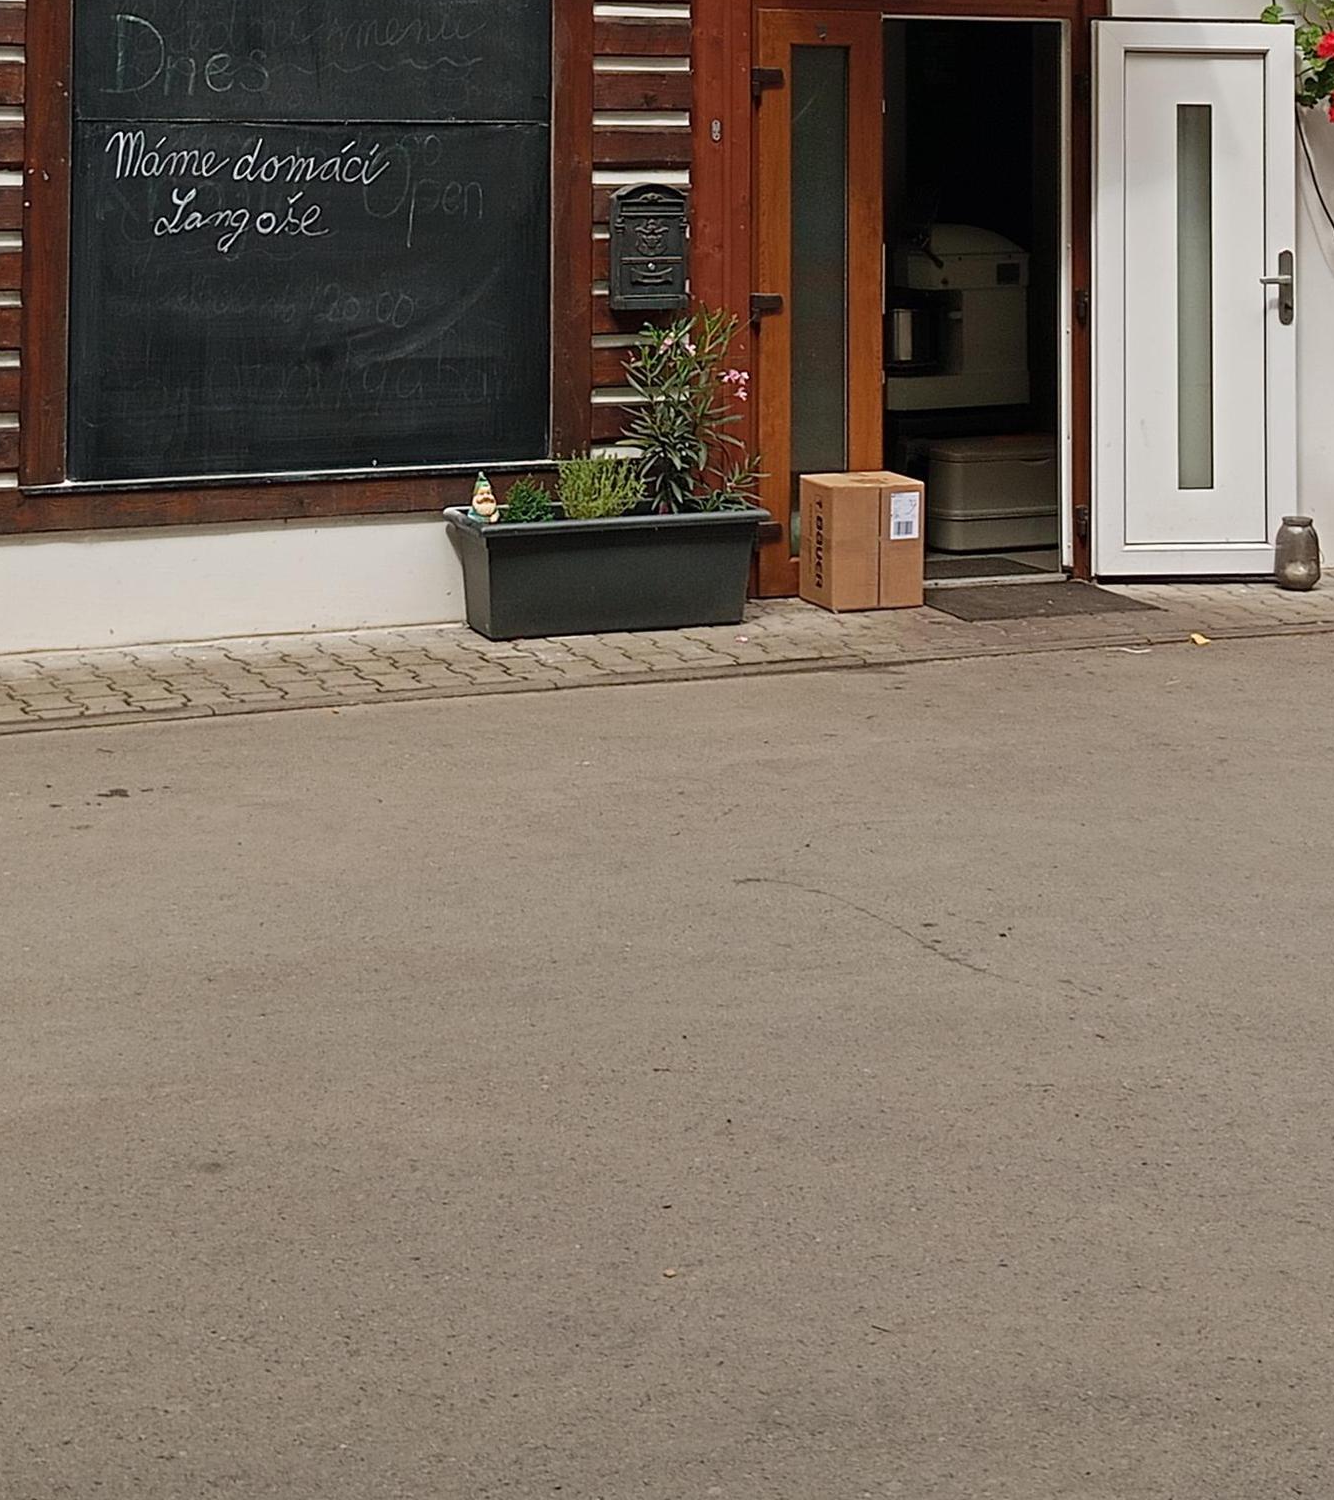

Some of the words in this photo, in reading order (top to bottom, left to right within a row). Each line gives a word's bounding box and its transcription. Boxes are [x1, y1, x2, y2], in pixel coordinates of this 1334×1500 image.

[100, 13, 268, 96] Dnes
[105, 130, 230, 180] Máme
[232, 138, 390, 185] domácí
